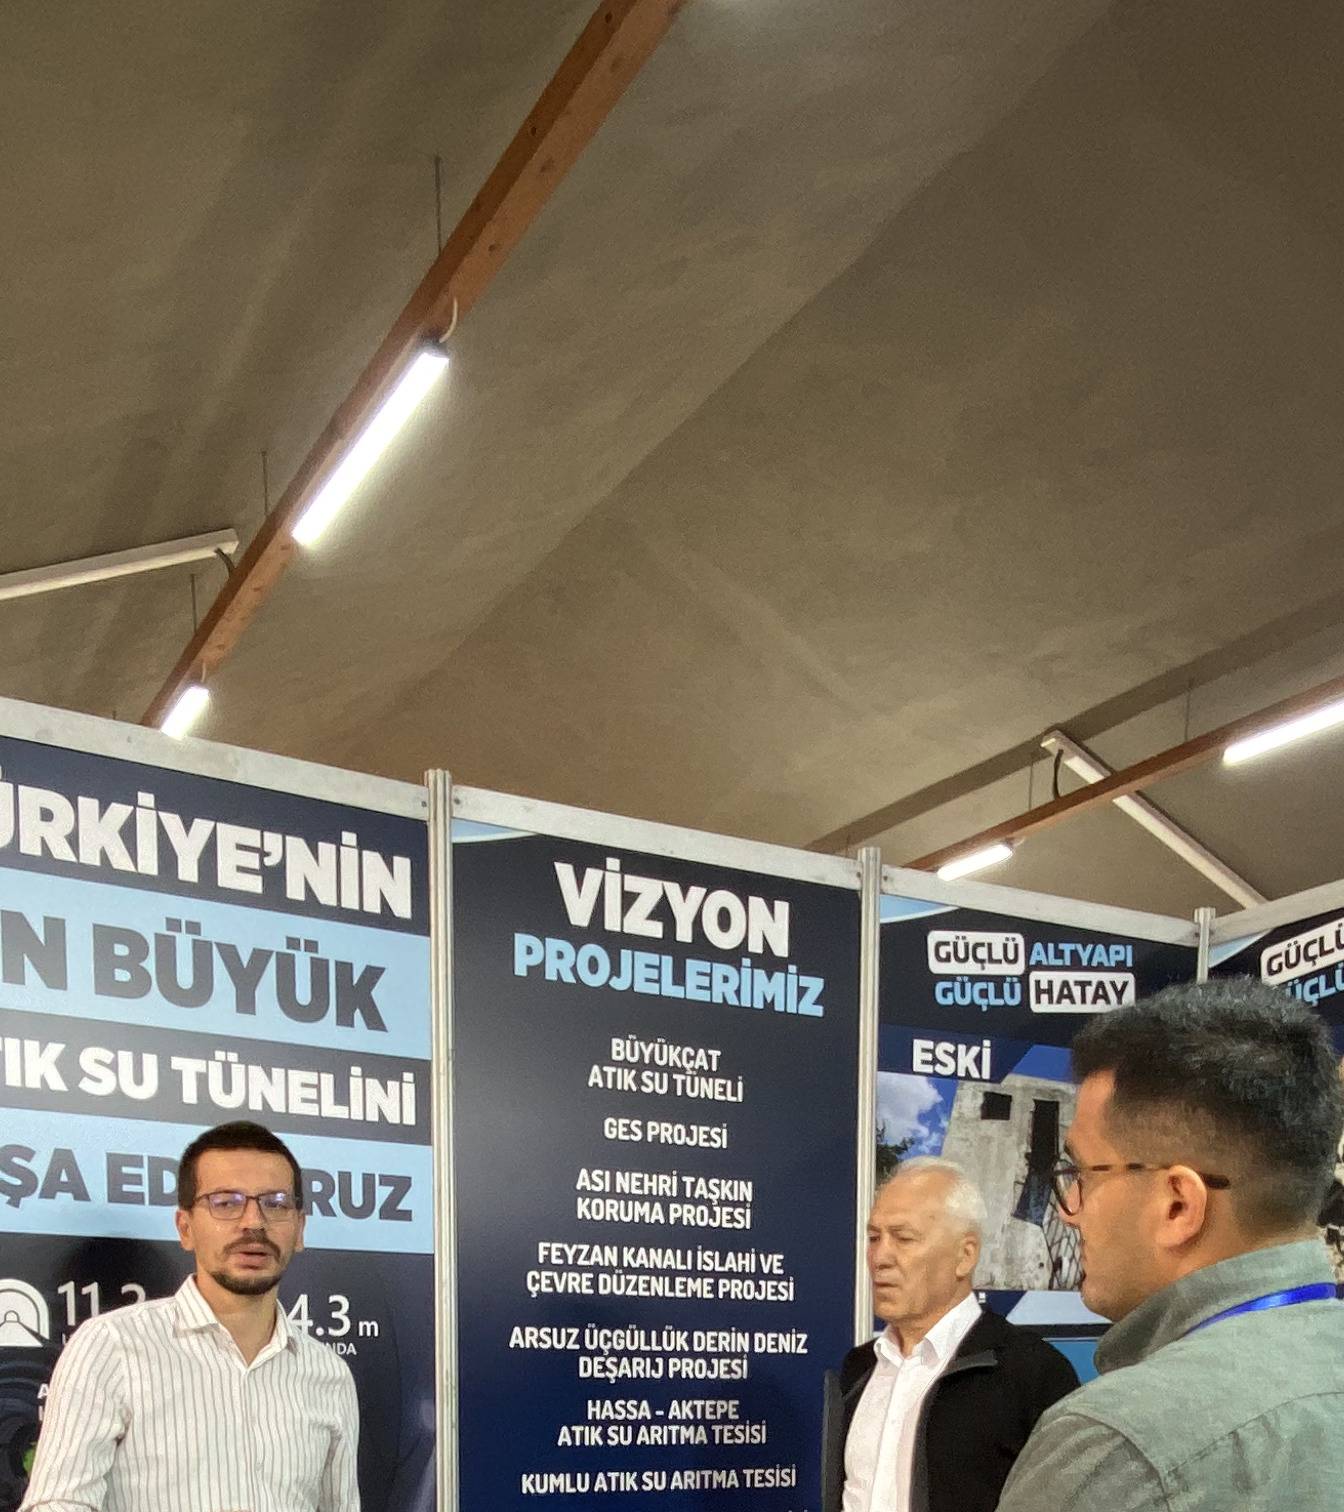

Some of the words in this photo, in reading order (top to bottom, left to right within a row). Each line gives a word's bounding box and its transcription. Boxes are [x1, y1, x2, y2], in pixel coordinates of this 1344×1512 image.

[554, 857, 789, 957] VİZYON
[934, 935, 1019, 970] GÜÇLÜ
[1029, 942, 1133, 968] ALTYAPI
[92, 916, 388, 1033] BÜYÜK
[514, 933, 824, 1017] PROJELERİMİZ
[935, 976, 1022, 1012] GÜÇLÜ
[1034, 979, 1130, 1006] HATAY
[611, 1034, 721, 1074] BÜYÜKÇAT
[912, 1038, 991, 1080] ESKİ
[79, 1049, 157, 1099] SU
[171, 1051, 416, 1126] TÜNELİNİ
[588, 1065, 636, 1092] ATIK
[641, 1070, 668, 1094] SU
[673, 1070, 743, 1102] TÜNELİ
[604, 1117, 642, 1141] GES
[647, 1121, 727, 1149] PROJESİ
[106, 1152, 413, 1222] EDRUZ
[576, 1168, 611, 1193] ASI
[616, 1170, 677, 1197] NEHRİ
[682, 1175, 752, 1204] TAŞKIN
[577, 1197, 665, 1225] KORUMA
[669, 1202, 751, 1229] PROJESİ
[538, 1242, 617, 1268] FEYZAN
[623, 1246, 692, 1271] KANALI
[697, 1247, 756, 1272] İSLAHİ
[760, 1254, 784, 1274] VE
[526, 1271, 593, 1298] ÇEVRE
[598, 1270, 713, 1298] DÜZENLEME
[718, 1277, 794, 1301] PROJESİ
[358, 1316, 379, 1336] m
[509, 1327, 579, 1350] ARSUZ
[585, 1324, 688, 1355] ÜÇGÜLLÜK
[693, 1328, 749, 1352] DERİN
[754, 1329, 807, 1354] DENİZ
[579, 1357, 663, 1383] DEŞARIJ
[668, 1354, 748, 1379] PROJESİ
[587, 1400, 651, 1420] HASSA
[668, 1399, 739, 1420] AKTEPE
[557, 1425, 600, 1446] ATIK
[607, 1425, 632, 1445] SU
[637, 1424, 707, 1445] ARITMA
[712, 1420, 766, 1444] TESİSİ
[521, 1472, 590, 1494] KUMLU
[594, 1471, 637, 1492] ATIK
[642, 1470, 666, 1491] SU
[671, 1469, 738, 1490] ARITMA
[743, 1464, 796, 1488] TESİSİ
